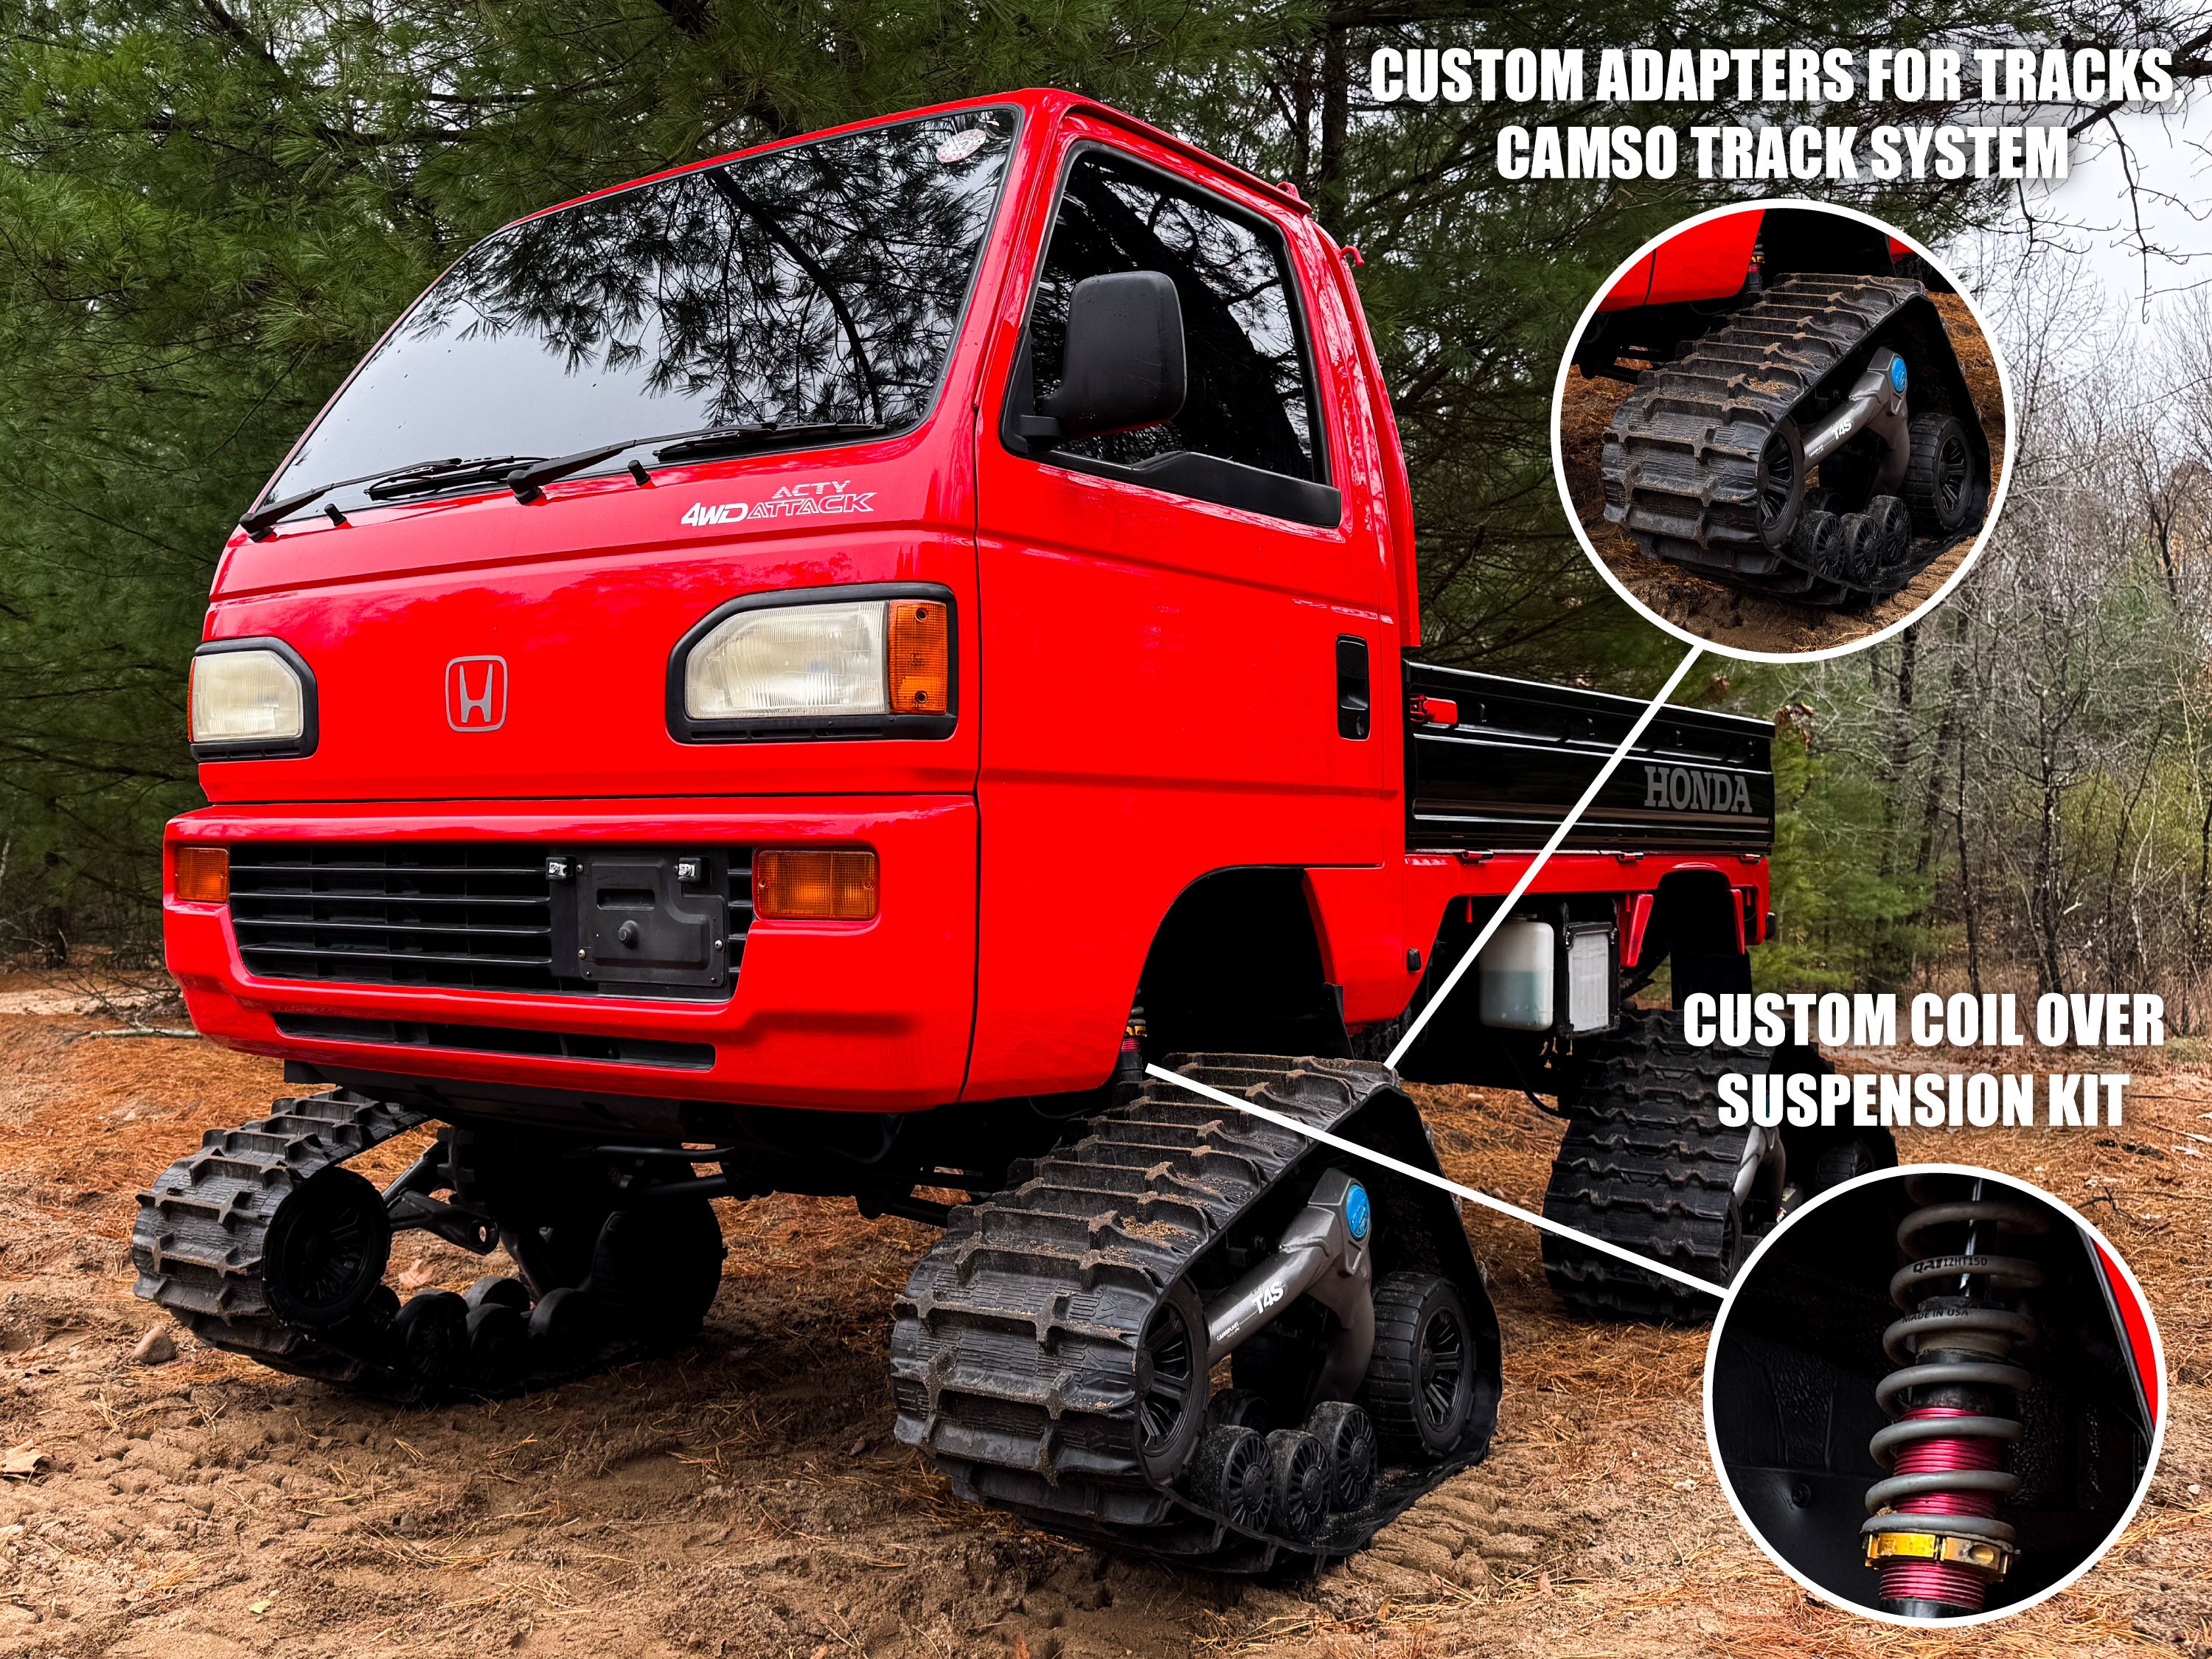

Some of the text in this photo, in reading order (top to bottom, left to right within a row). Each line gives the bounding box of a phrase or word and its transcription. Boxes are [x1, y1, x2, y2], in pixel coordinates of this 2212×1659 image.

[1831, 418, 1851, 440] T4S
[771, 479, 851, 499] ACTY
[681, 493, 877, 527] 4WD ATTACK
[1644, 765, 1753, 813] HONDA
[1251, 1281, 1284, 1314] T4S
[1902, 1309, 1969, 1324] MADE IN USA
